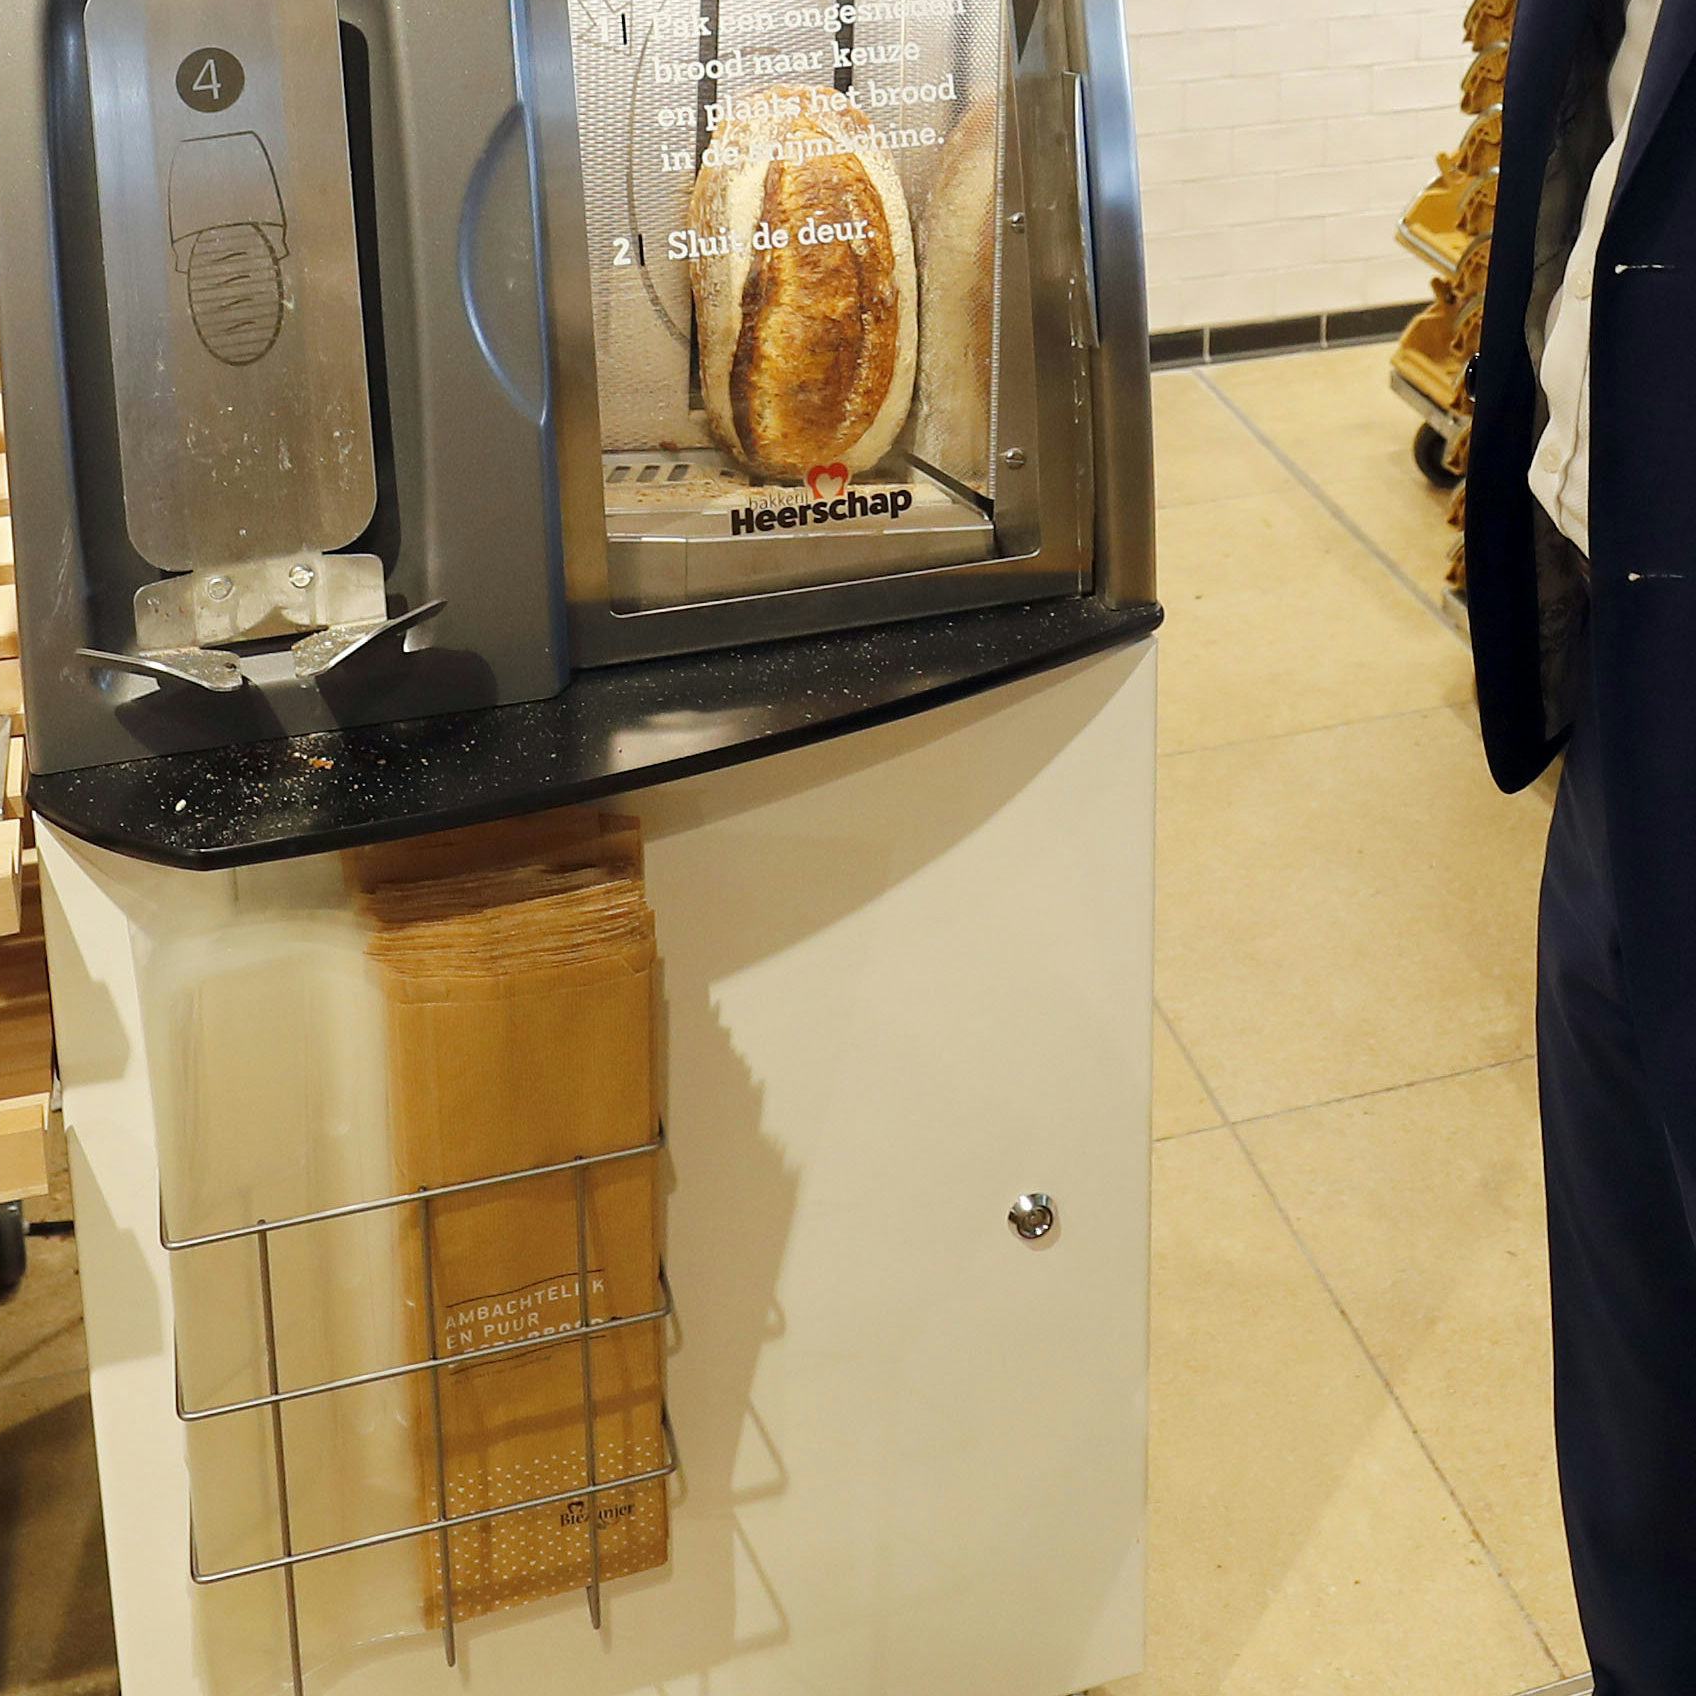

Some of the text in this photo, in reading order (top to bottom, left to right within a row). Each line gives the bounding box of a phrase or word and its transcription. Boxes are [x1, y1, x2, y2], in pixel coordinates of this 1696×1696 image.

[719, 10, 780, 36] een
[192, 58, 222, 100] 4
[652, 38, 921, 85] brood naar keuze
[657, 73, 957, 133] en plaats het brood
[659, 145, 699, 174] in
[702, 141, 742, 169] de
[667, 225, 744, 261] Sluit
[752, 220, 790, 251] de
[797, 215, 876, 246] deur.
[730, 489, 913, 536] Heerschap
[748, 491, 809, 511] bakkerij
[445, 1279, 604, 1329] AMBACHTELIK
[446, 1329, 473, 1350] EN
[484, 1312, 540, 1338] PUUR
